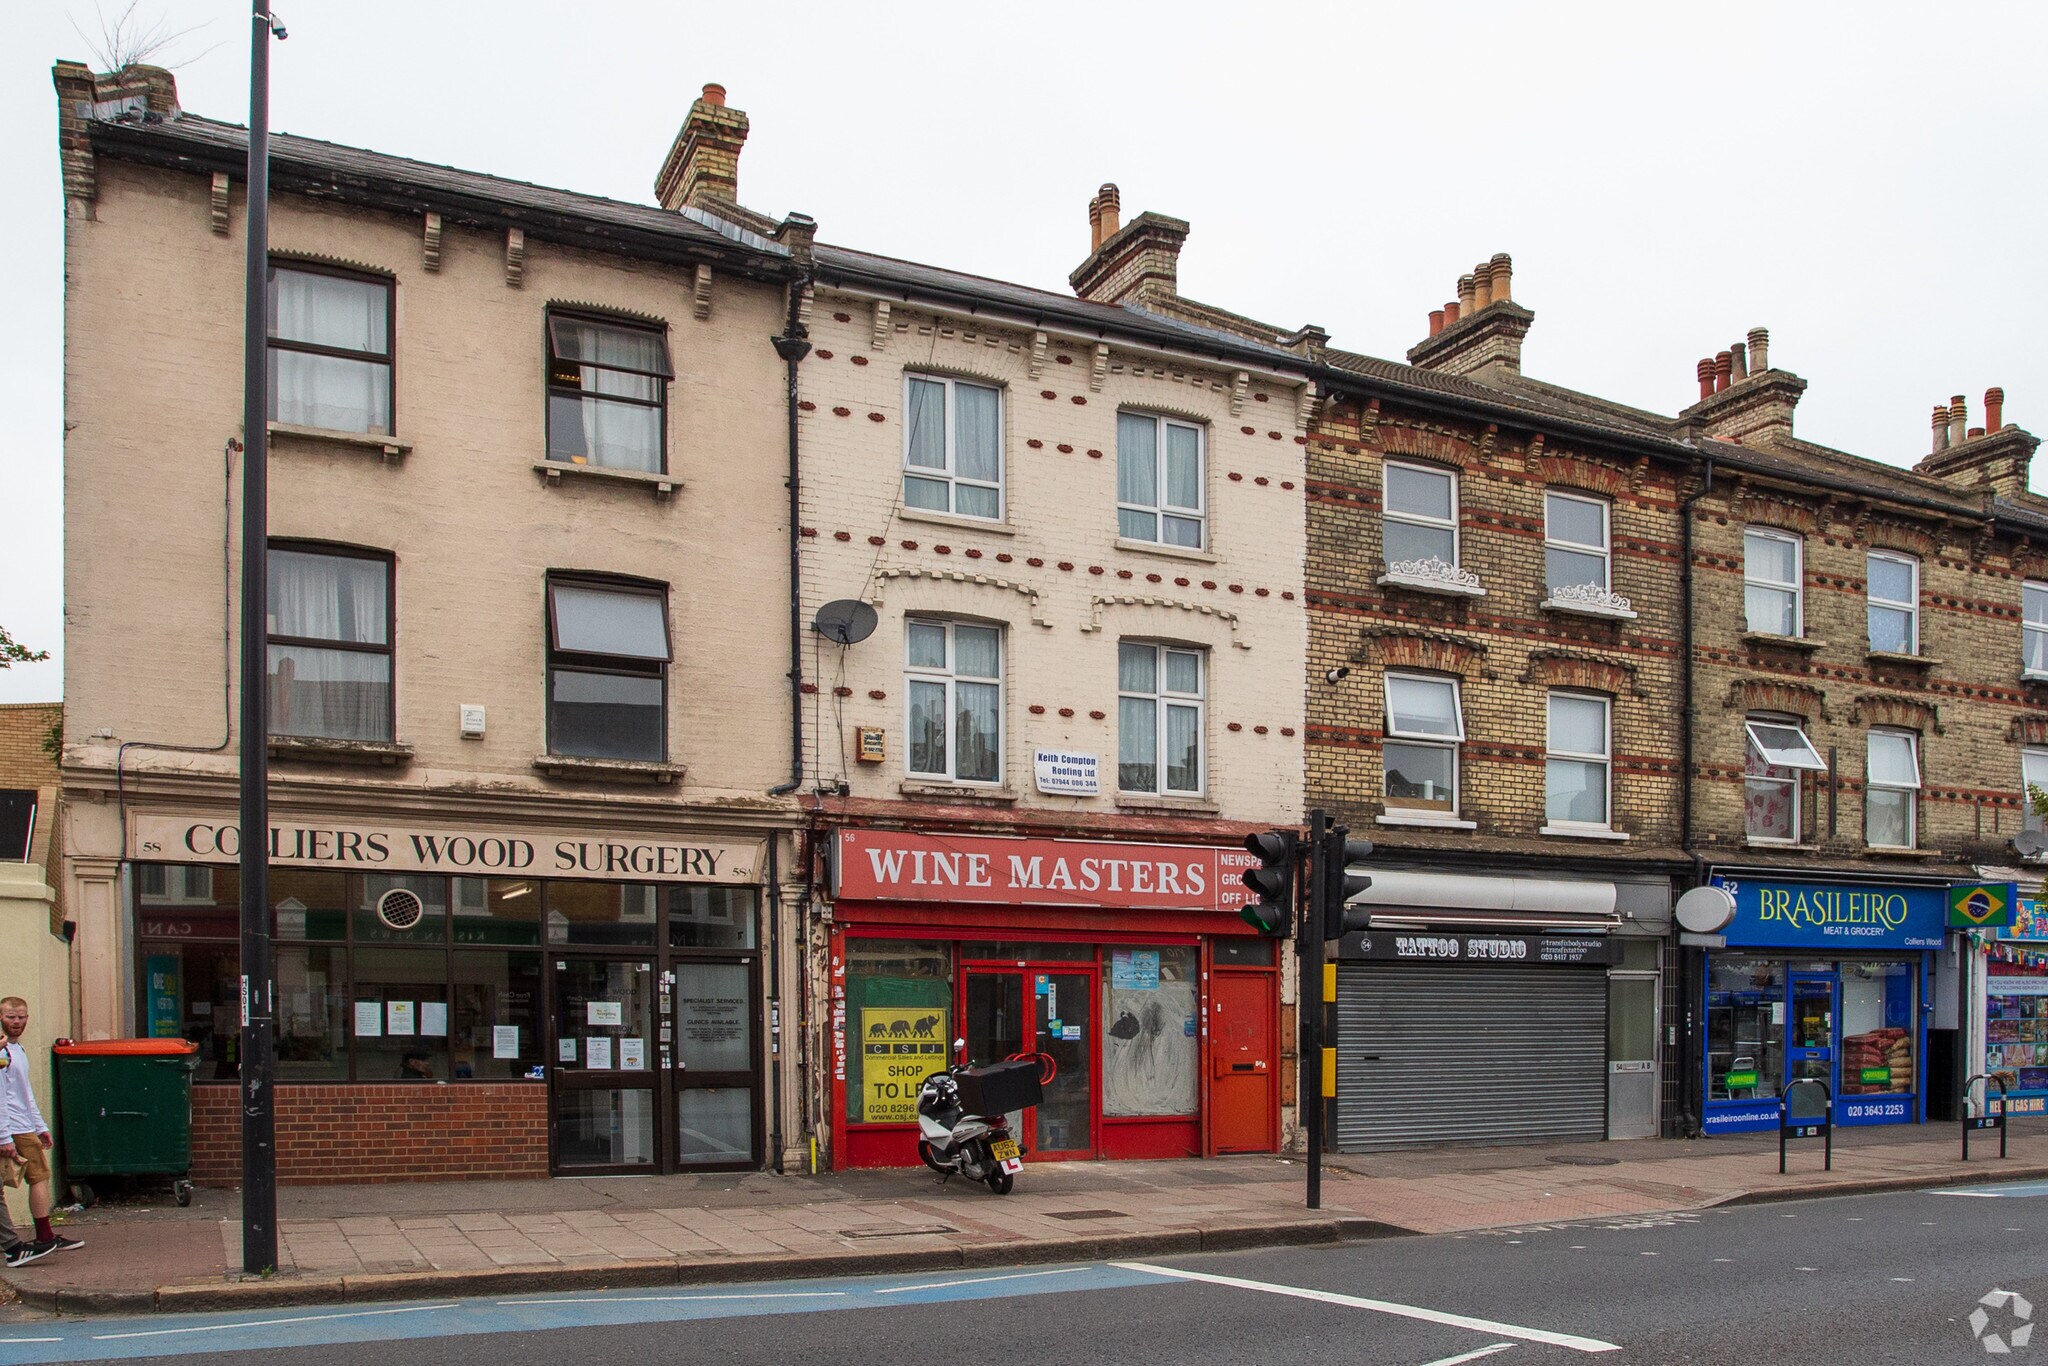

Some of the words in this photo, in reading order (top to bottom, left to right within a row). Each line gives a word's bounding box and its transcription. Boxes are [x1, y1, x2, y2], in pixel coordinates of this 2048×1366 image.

[1038, 753, 1058, 762] Keith
[1061, 755, 1096, 765] Compton
[1052, 766, 1082, 777] Roofing
[1085, 769, 1095, 777] Ltd
[845, 833, 856, 842] 56
[143, 841, 161, 852] 58
[184, 823, 390, 862] COLIERS
[409, 832, 534, 868] WOOD
[555, 841, 726, 876] SURGERY
[865, 848, 991, 887] WINE
[1008, 854, 1206, 897] MASTERS
[1722, 881, 1738, 895] 52
[1222, 892, 1241, 905] OFF
[1759, 889, 1908, 931] BRASILEIRO
[1823, 926, 1843, 935] MEAT
[1844, 927, 1850, 935] &
[1850, 927, 1885, 936] GROCERY
[1395, 937, 1459, 956] TATTOO
[1468, 939, 1526, 958] STUDIO
[1904, 937, 1925, 946] Colliers
[1926, 938, 1942, 946] Wood
[873, 1045, 882, 1053] C
[901, 1045, 909, 1053] S
[929, 1045, 935, 1053] J
[888, 1065, 923, 1077] SHOP
[1616, 1063, 1623, 1071] 54
[1641, 1062, 1646, 1070] A
[873, 1083, 899, 1099] TO
[868, 1104, 888, 1114] 020
[890, 1104, 915, 1113] 8296
[1847, 1106, 1862, 1117] 020
[1864, 1105, 1883, 1116] 3643
[1885, 1104, 1904, 1115] 2253
[2015, 1098, 2028, 1112] GAS
[2029, 1098, 2045, 1111] HIRE
[1005, 1158, 1019, 1170] L
